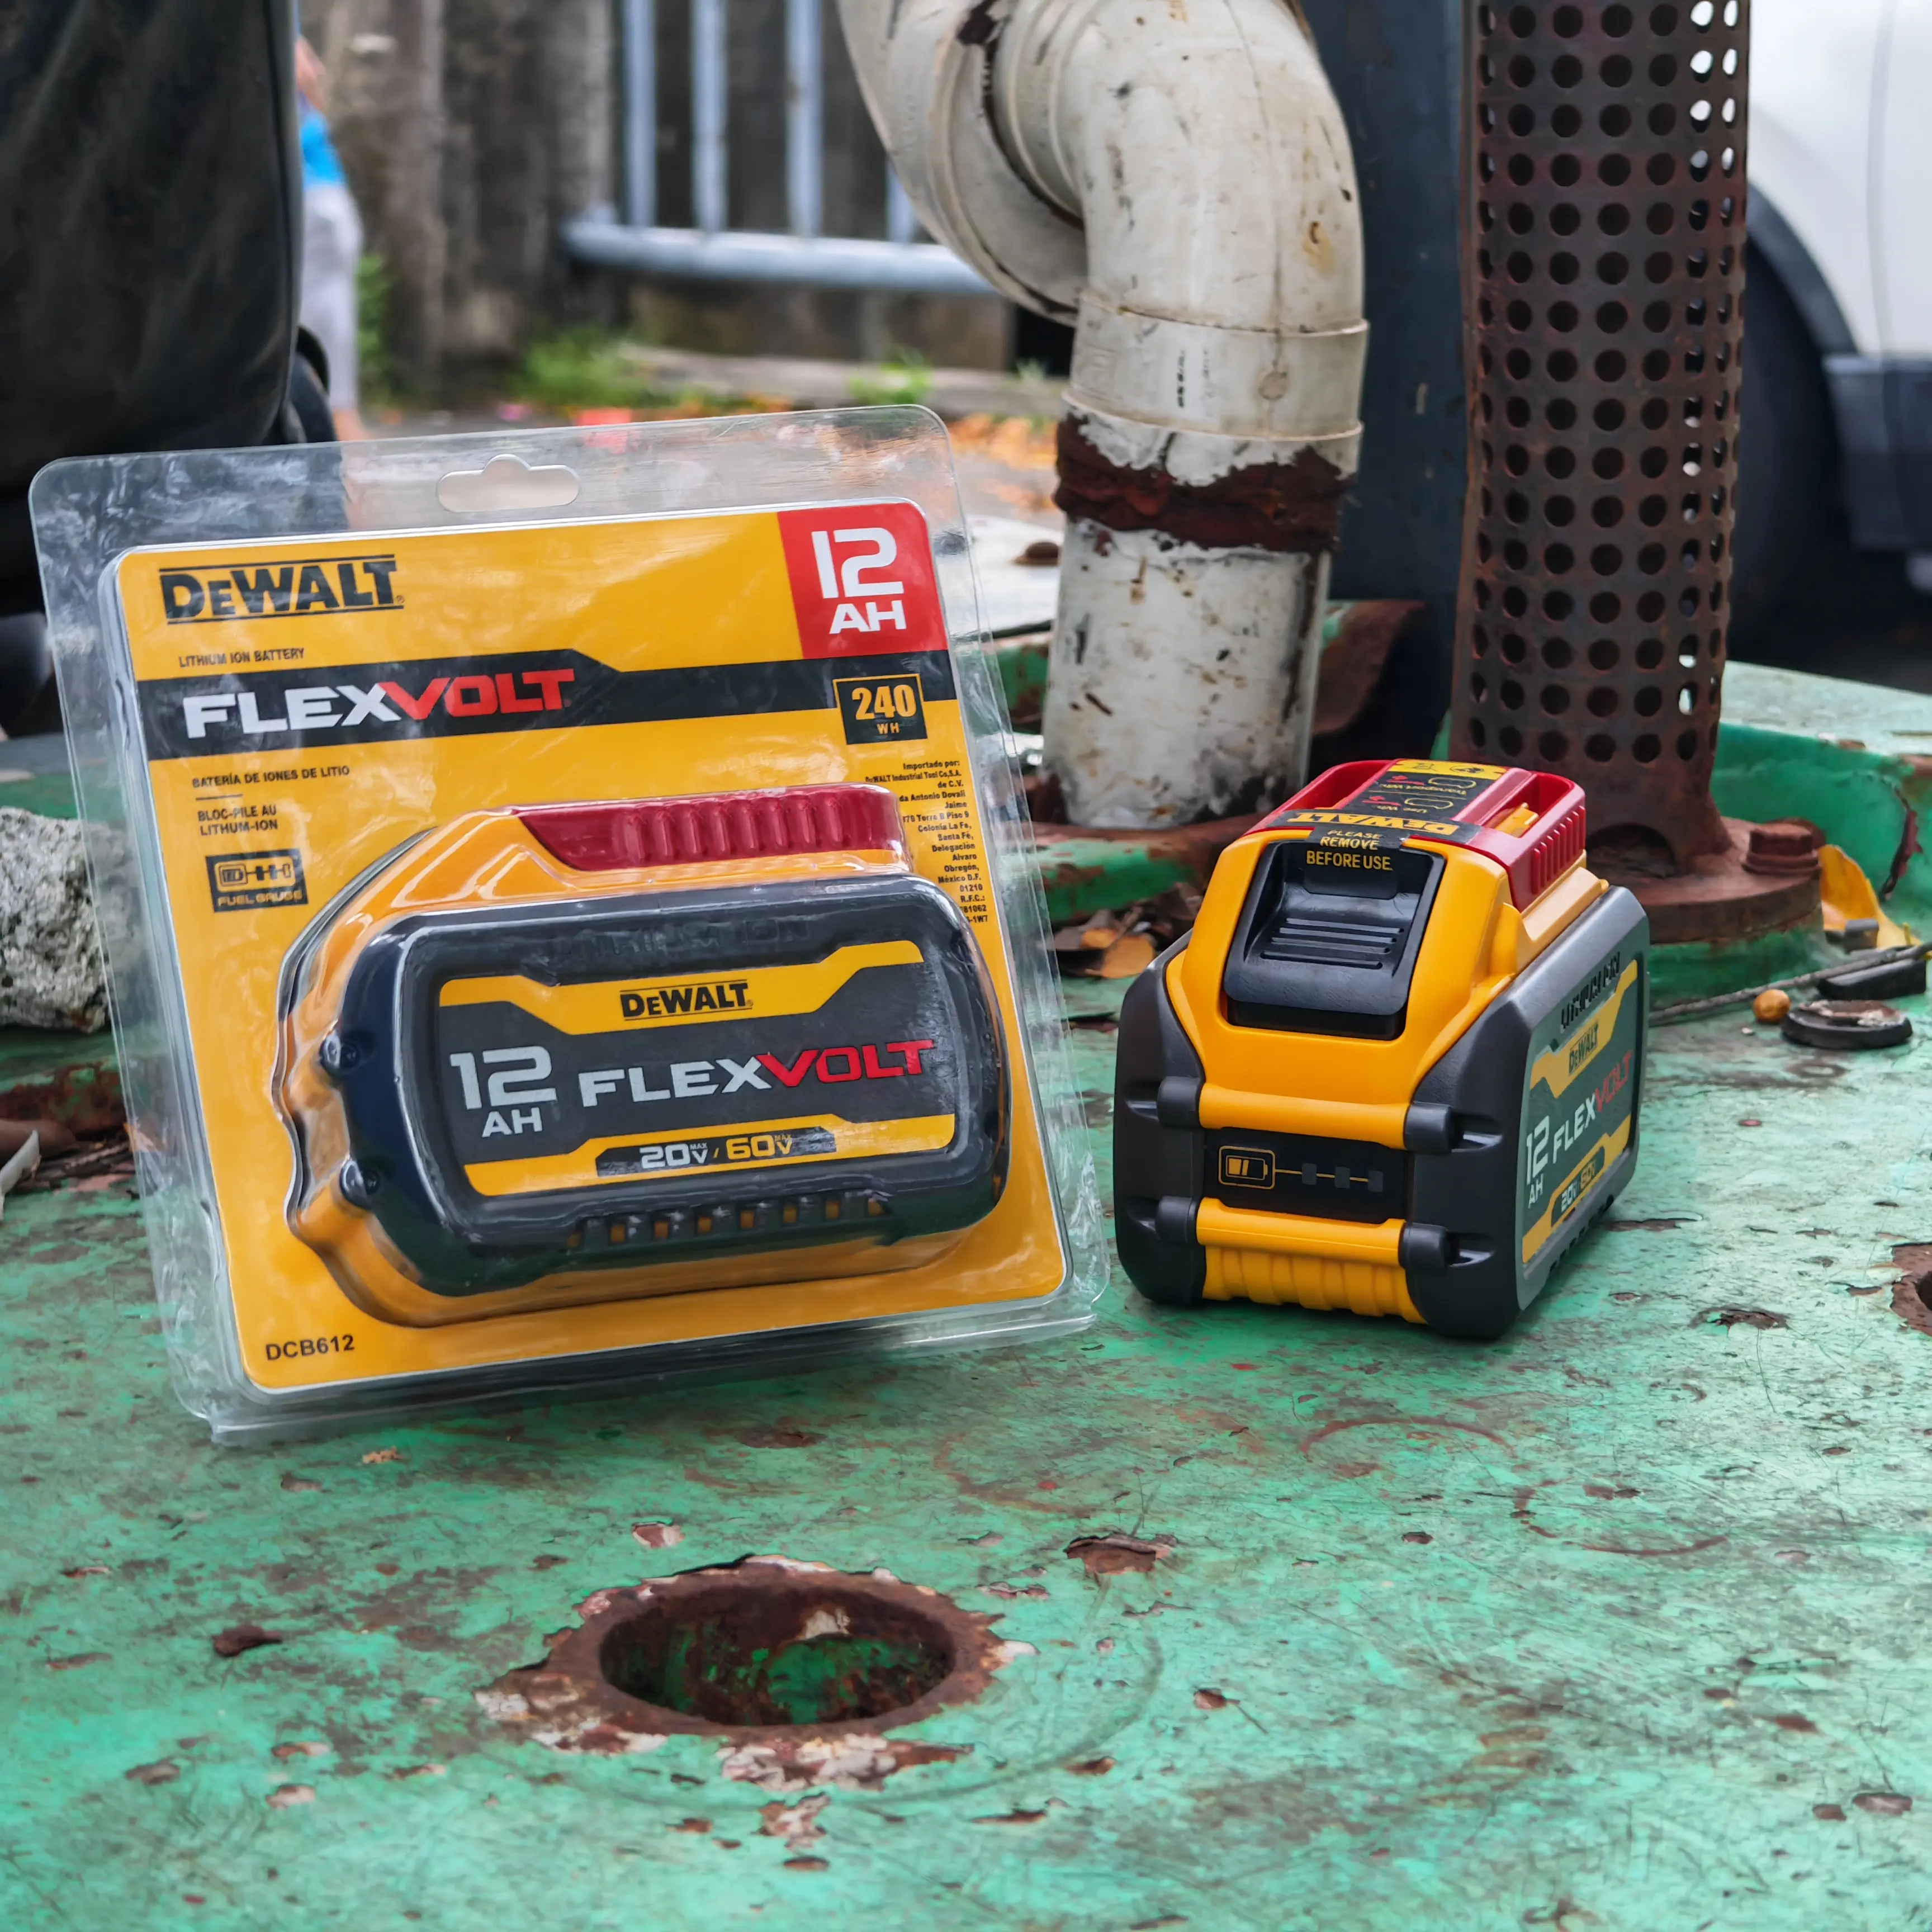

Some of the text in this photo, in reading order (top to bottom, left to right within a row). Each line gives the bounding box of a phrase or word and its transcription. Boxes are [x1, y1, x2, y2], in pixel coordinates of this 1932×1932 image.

[811, 527, 904, 599] 12
[829, 600, 907, 634] AH
[179, 647, 305, 667] LITHIUM ION BATTERY
[183, 668, 575, 739] FLEXVOLT
[851, 684, 916, 721] 240
[877, 722, 901, 736] WH
[903, 760, 960, 771] Importado por:
[192, 765, 350, 788] BATERÍA DE IONES DE LITIO
[892, 773, 923, 782] Industrial
[911, 792, 940, 801] Antonio
[198, 804, 277, 822] BLOC-PILE AU
[916, 814, 938, 822] Torre
[200, 819, 278, 836] LITHUM-ION
[918, 823, 947, 832] Colonia
[1327, 830, 1384, 839] PLEASE
[937, 833, 960, 841] Santa
[1319, 836, 1380, 850] REMOVE
[932, 841, 976, 853] Delegación
[1306, 850, 1394, 870] BEFORE USE
[937, 873, 981, 883] México D.F.
[959, 883, 983, 892] 01210
[217, 890, 304, 907] FUEL GAUGE
[450, 1046, 557, 1109] 12
[577, 1039, 934, 1107] FLEXVOLT
[1553, 1050, 1633, 1164] FLEXVOLT
[482, 1107, 542, 1138] AH
[1527, 1116, 1550, 1186] 12
[1528, 1173, 1543, 1209] AH
[266, 1333, 356, 1361] DCB612
